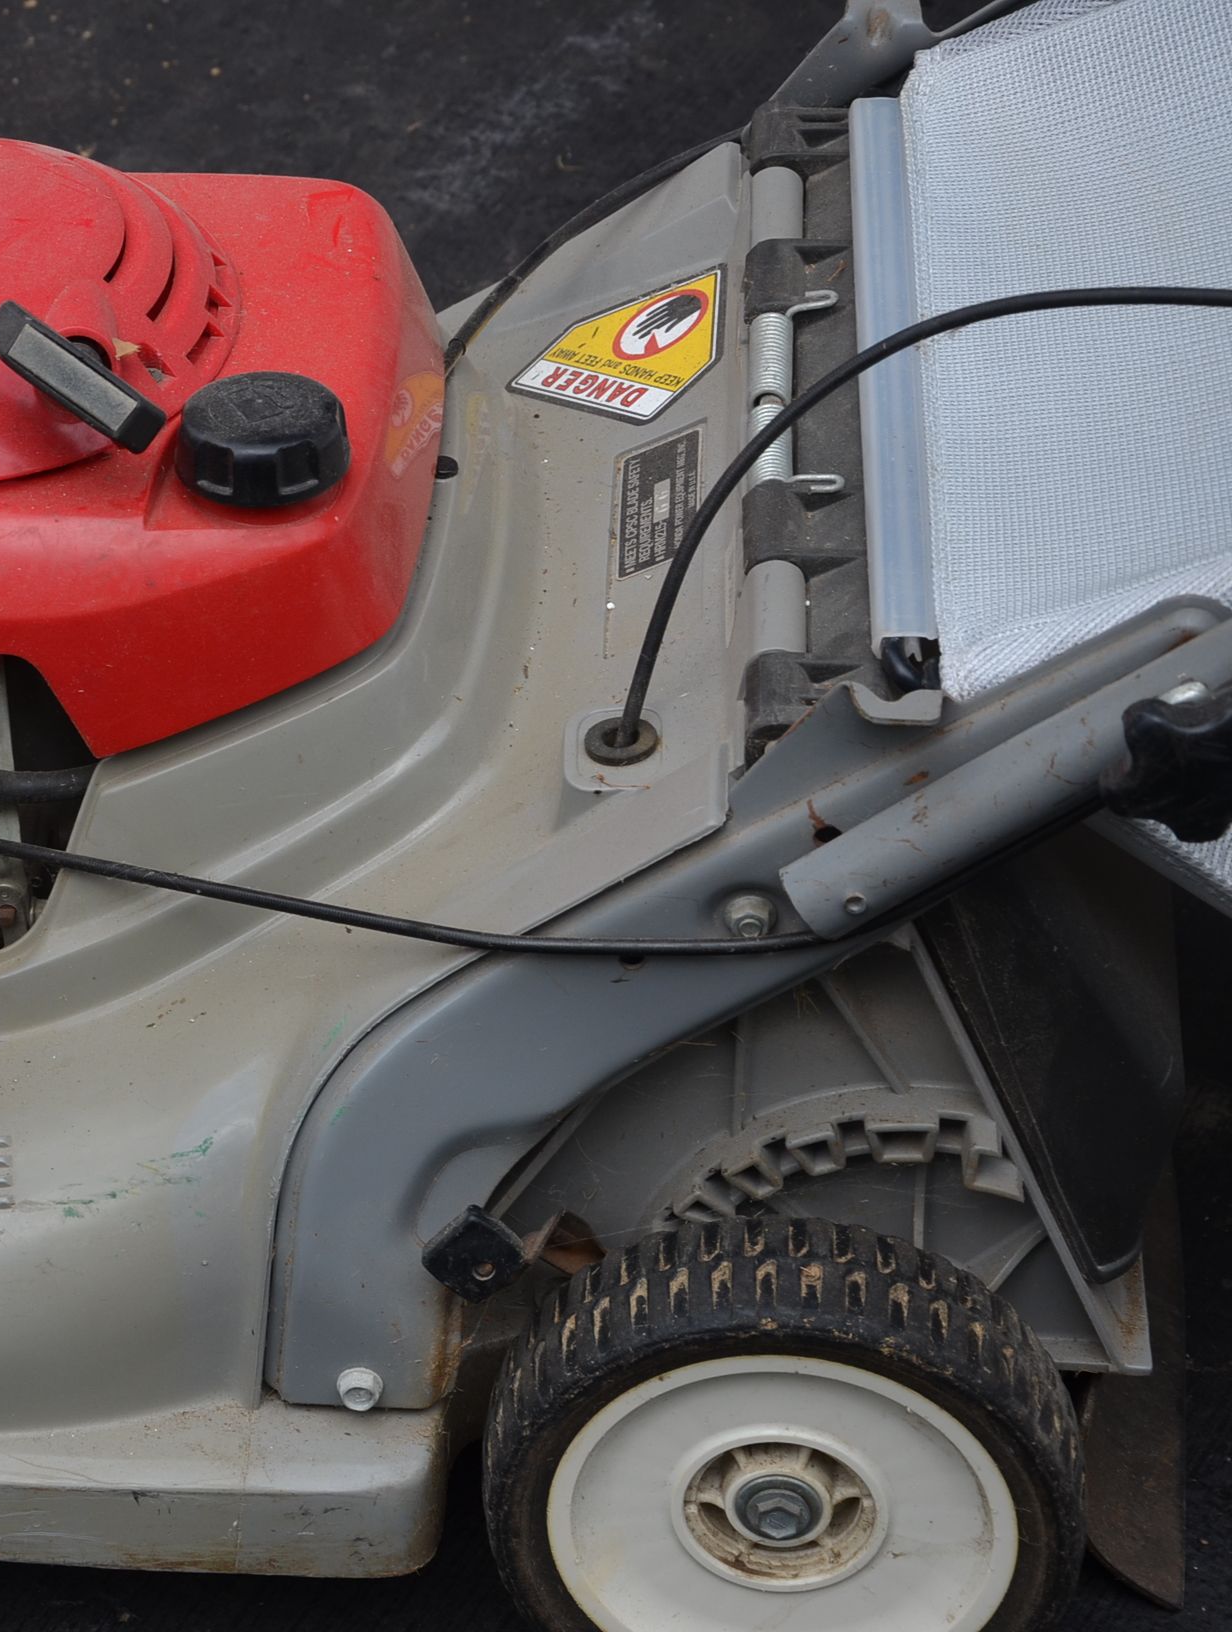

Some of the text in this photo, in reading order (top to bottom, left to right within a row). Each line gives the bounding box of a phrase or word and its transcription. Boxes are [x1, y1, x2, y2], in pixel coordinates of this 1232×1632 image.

[541, 366, 649, 408] DANGER
[550, 346, 685, 388] KEEP HANDS and FEET AWAY
[624, 458, 641, 569] MEETS CPSC BLADE SAFETY
[638, 497, 653, 563] REQUIREMENTS.
